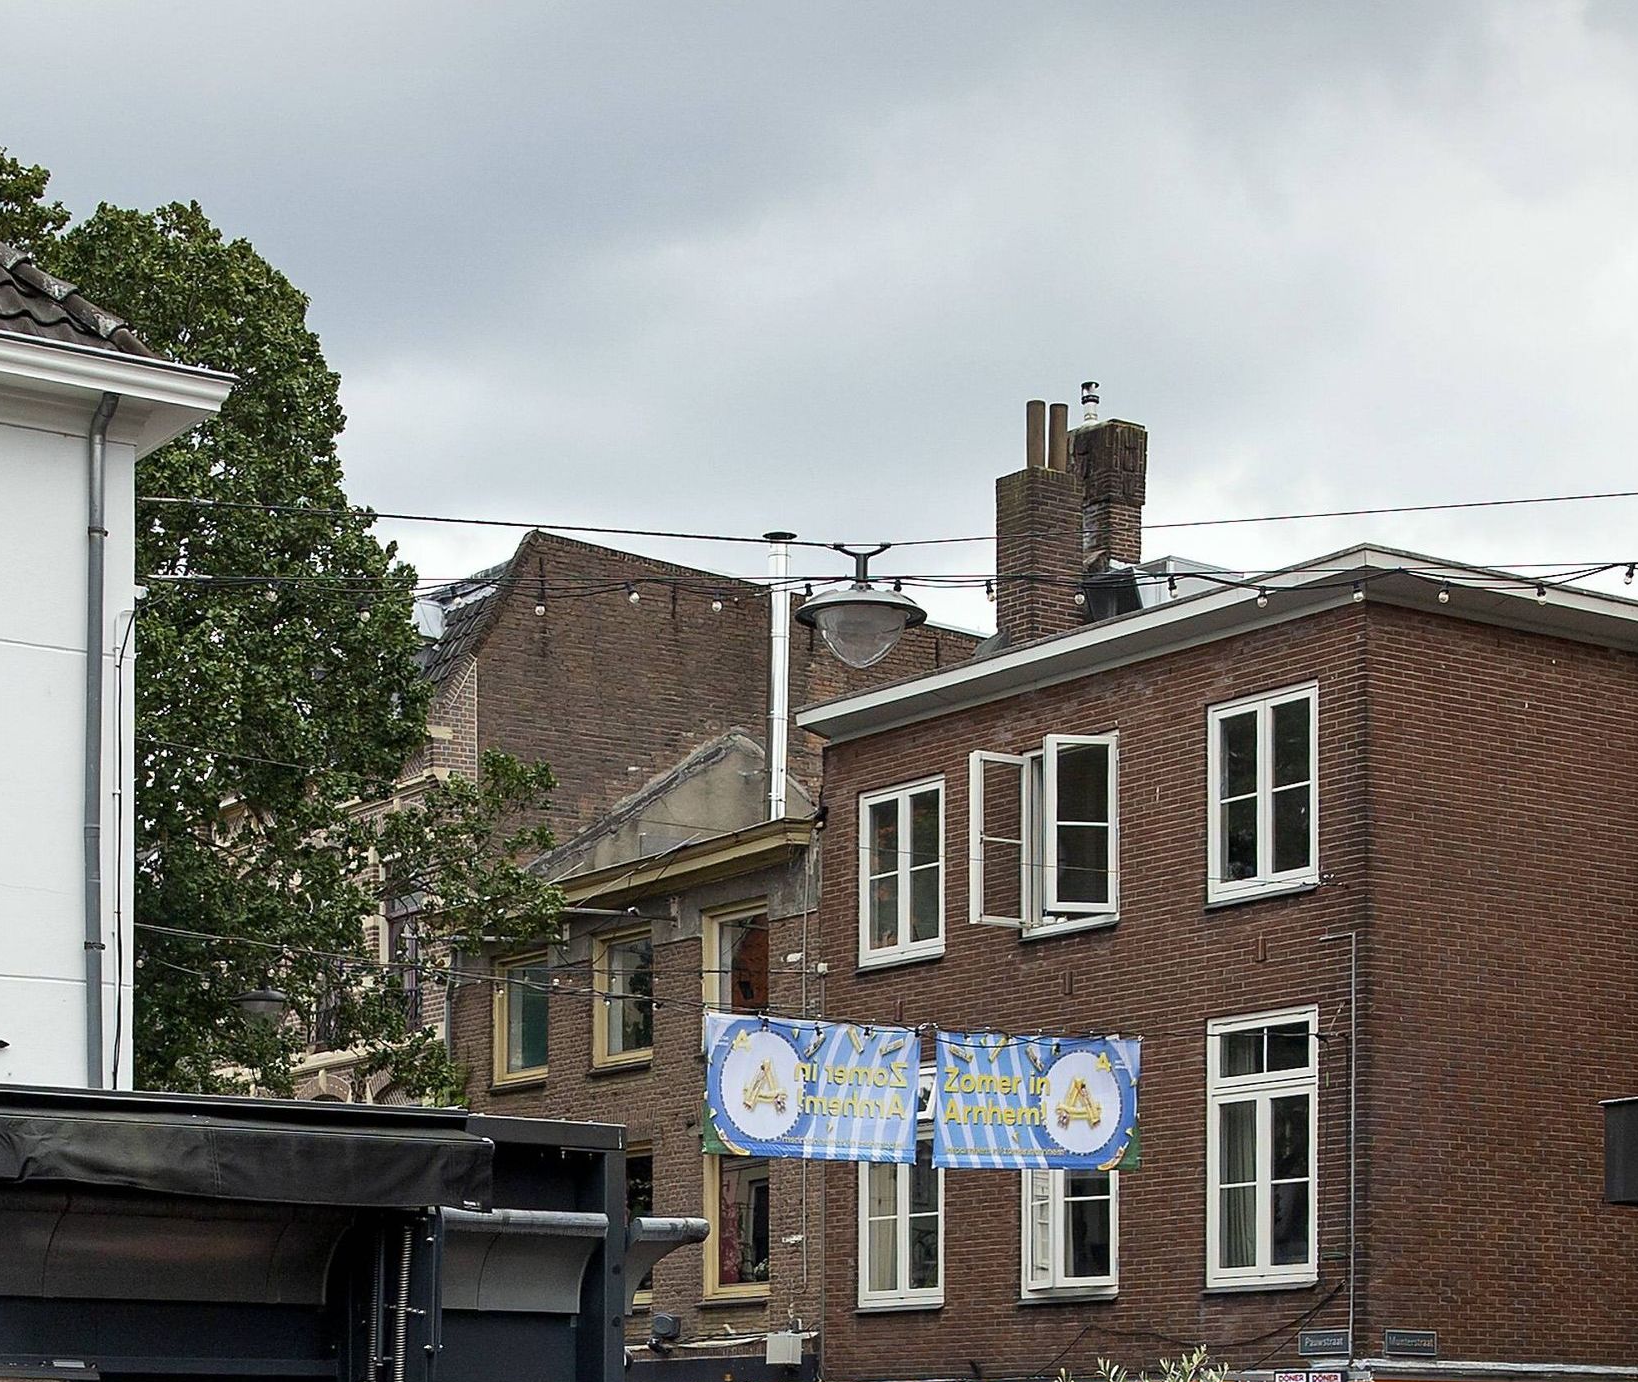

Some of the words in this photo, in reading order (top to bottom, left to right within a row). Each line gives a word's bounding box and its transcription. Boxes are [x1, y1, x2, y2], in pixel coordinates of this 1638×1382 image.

[943, 1065, 1022, 1095] Zomer
[1028, 1070, 1052, 1097] in
[944, 1098, 1048, 1127] Arnhem!
[1304, 1336, 1344, 1347] Pauwstraat
